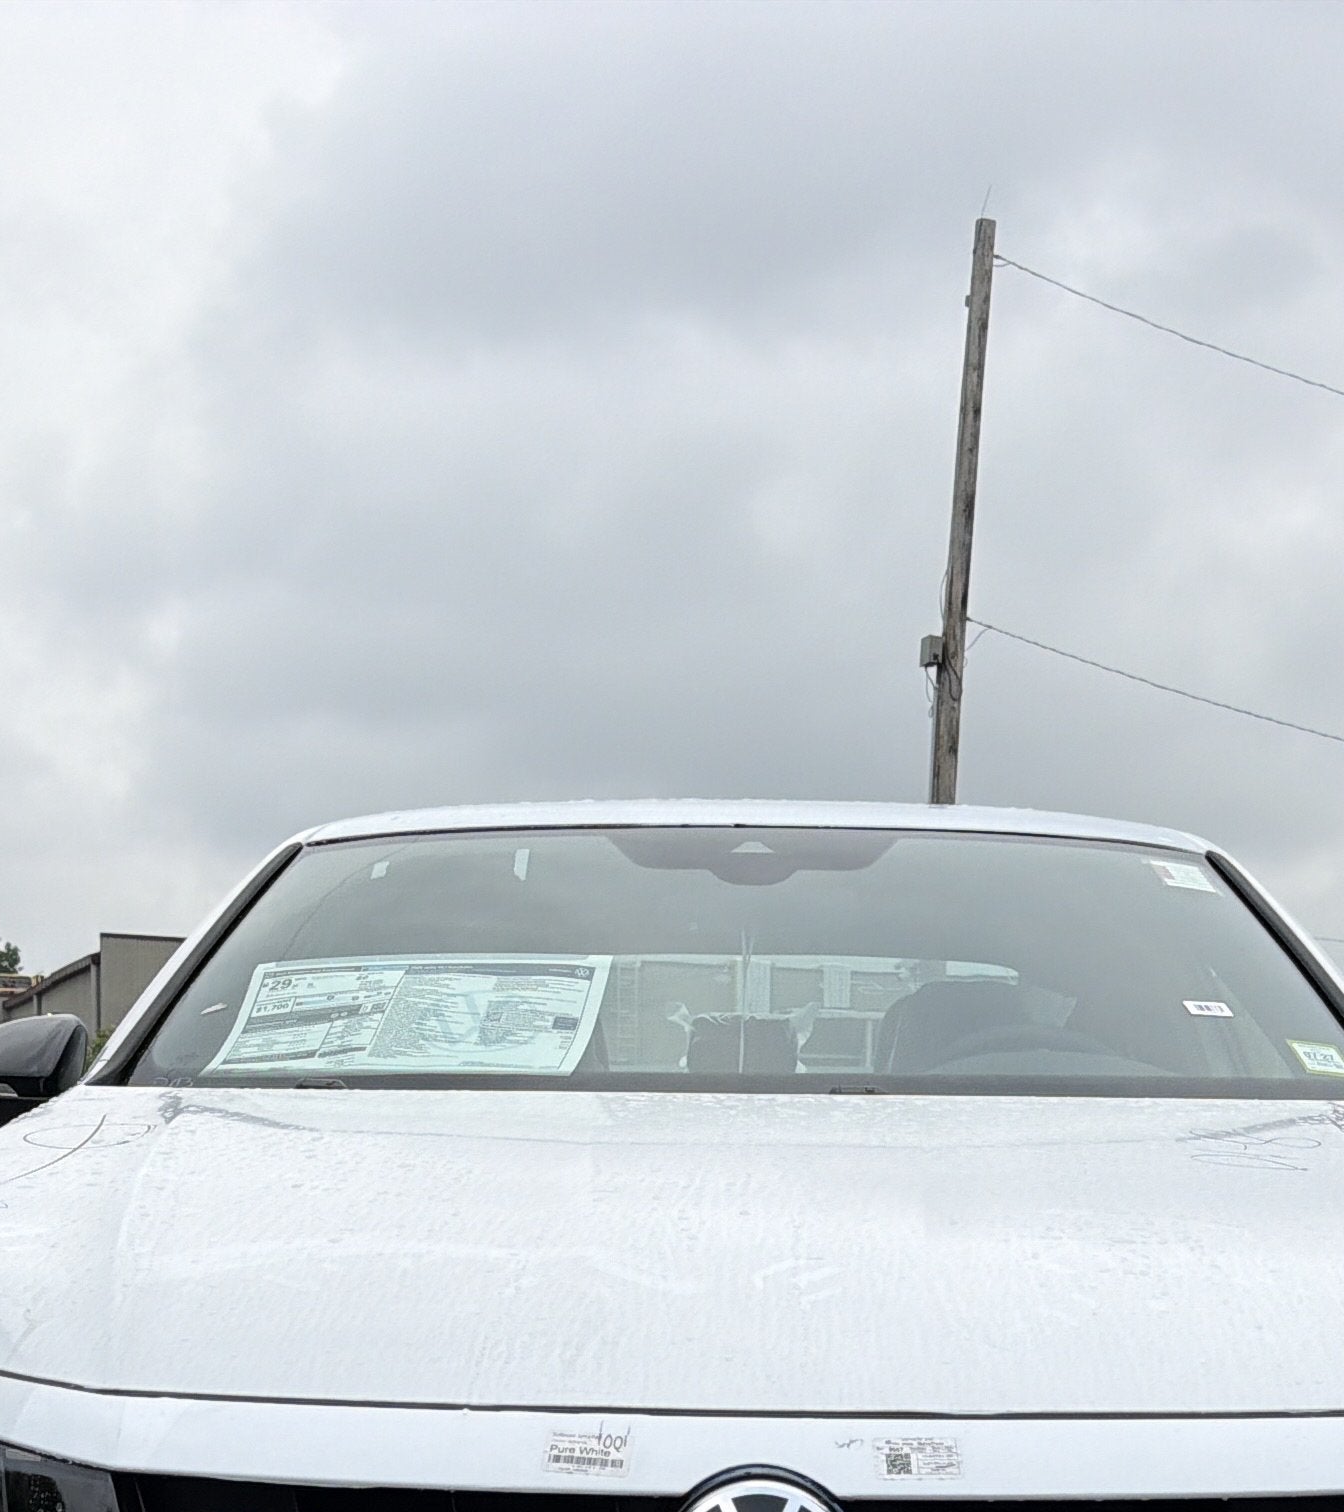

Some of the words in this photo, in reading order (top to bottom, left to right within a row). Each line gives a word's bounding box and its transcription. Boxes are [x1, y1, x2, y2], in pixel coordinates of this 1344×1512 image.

[268, 978, 293, 992] 29
[549, 1443, 576, 1455] Pure
[579, 1445, 612, 1458] White
